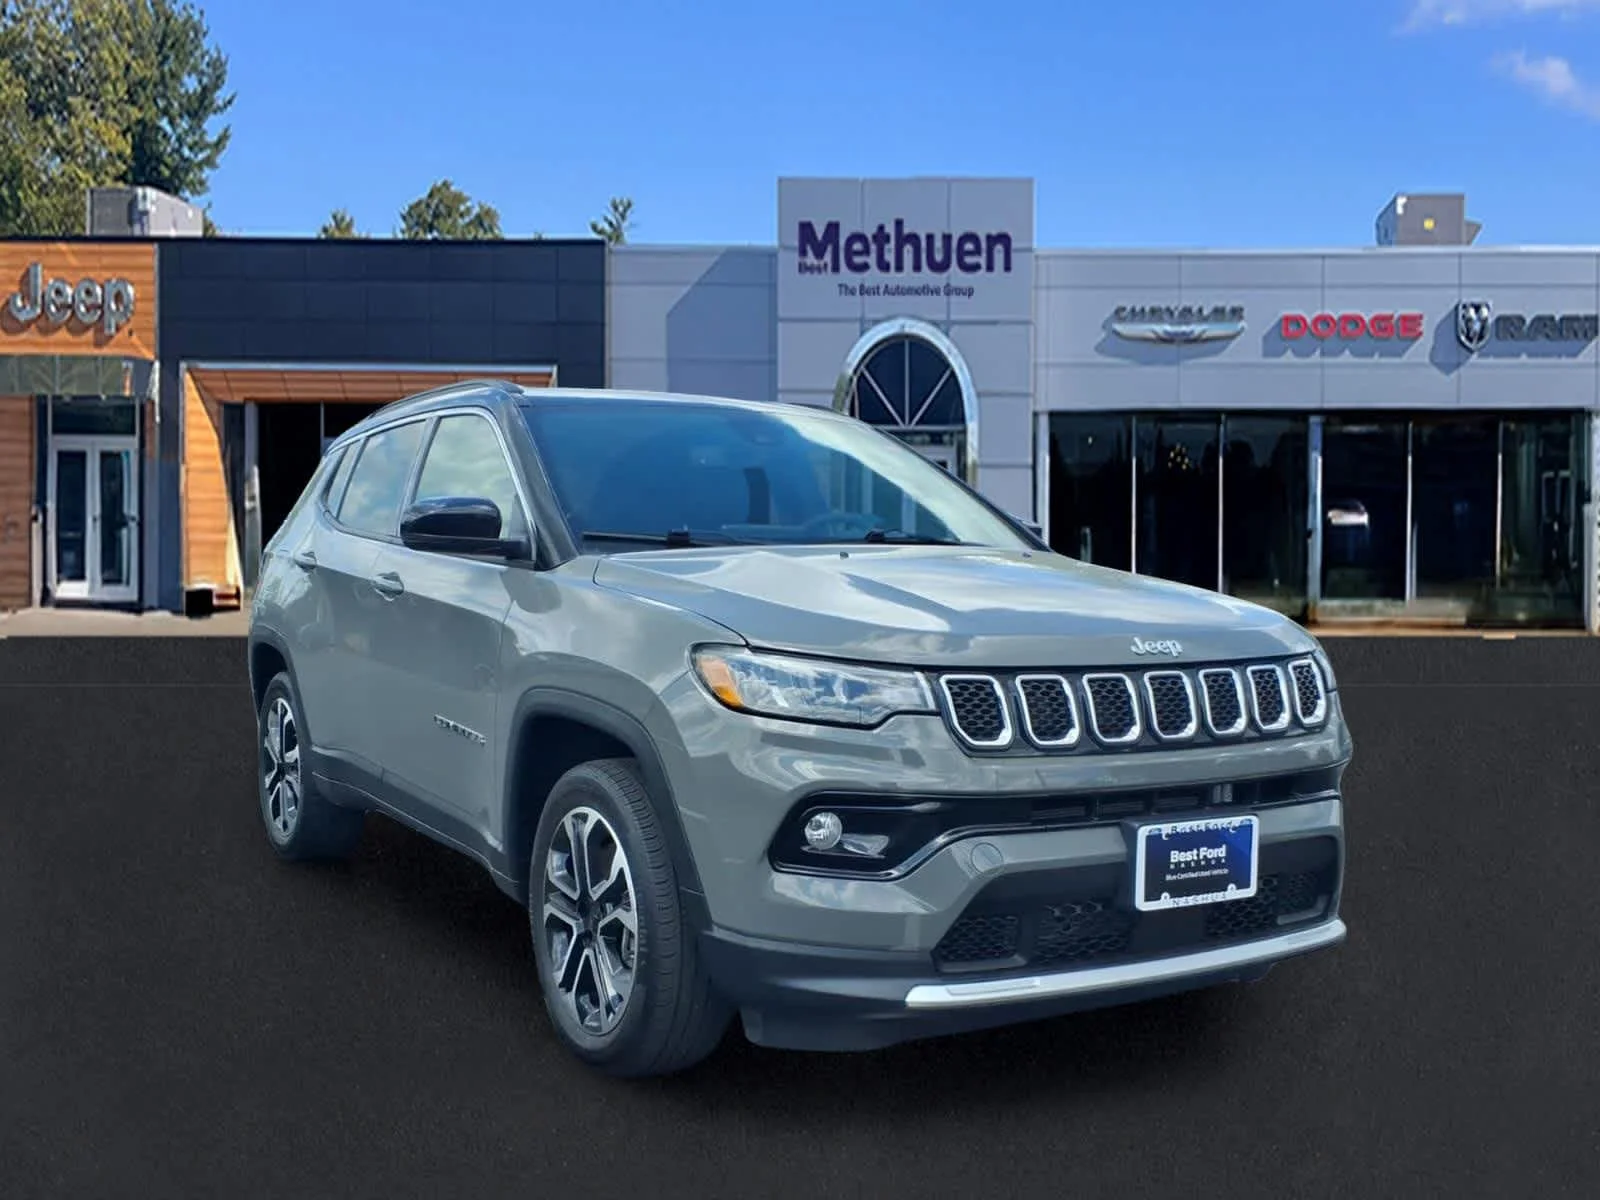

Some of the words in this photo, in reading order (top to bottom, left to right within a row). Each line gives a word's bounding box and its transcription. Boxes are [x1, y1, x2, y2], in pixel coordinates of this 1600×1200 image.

[798, 218, 1012, 274] Methuen
[10, 262, 134, 335] Jeep
[838, 283, 857, 297] The
[859, 283, 880, 297] Best
[883, 283, 941, 297] Automotive
[943, 283, 975, 299] Group
[1281, 313, 1424, 340] DODGE
[1495, 313, 1599, 341] RAM
[1130, 636, 1183, 657] Jeep
[1170, 848, 1198, 862] Best
[1199, 844, 1227, 860] Ford
